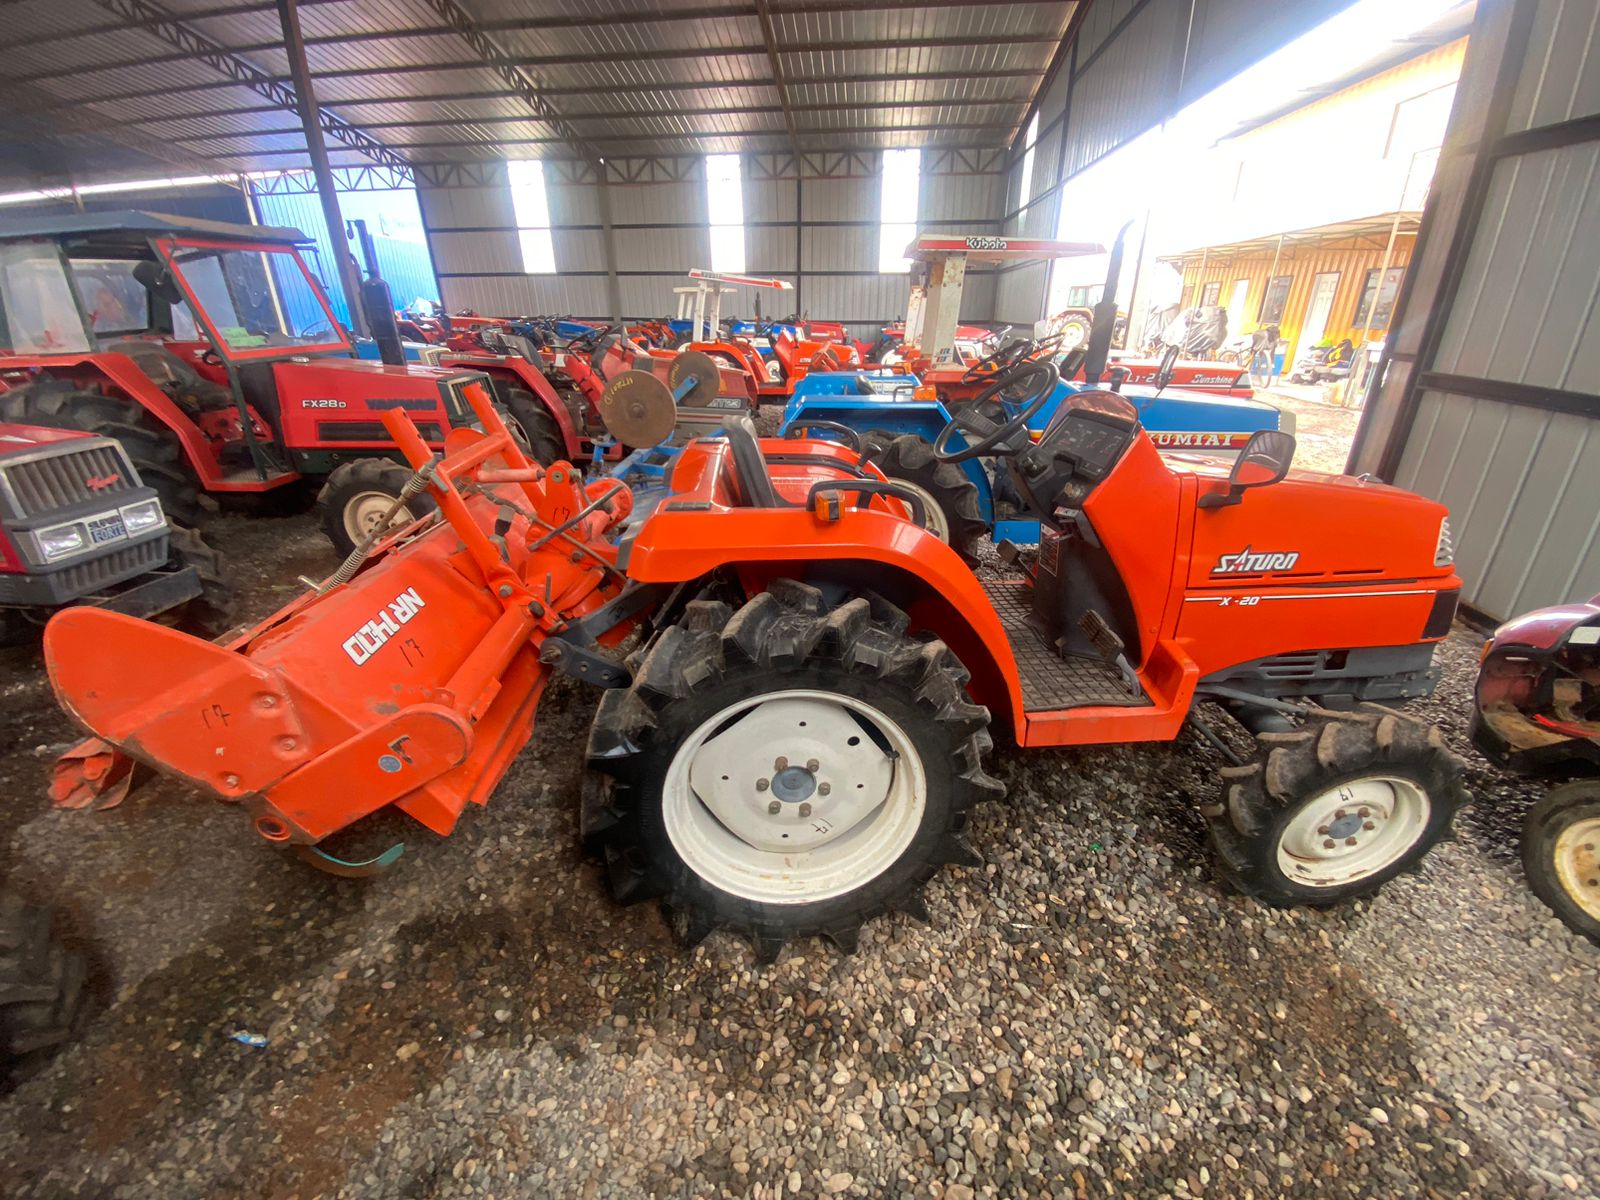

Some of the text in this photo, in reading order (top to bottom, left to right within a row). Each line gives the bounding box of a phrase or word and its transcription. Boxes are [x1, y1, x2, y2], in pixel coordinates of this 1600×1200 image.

[966, 237, 1008, 249] Kubota
[1191, 374, 1235, 384] Sunshine
[93, 524, 126, 541] FORTE
[1211, 545, 1299, 573] SATURN
[341, 585, 426, 667] NR1400
